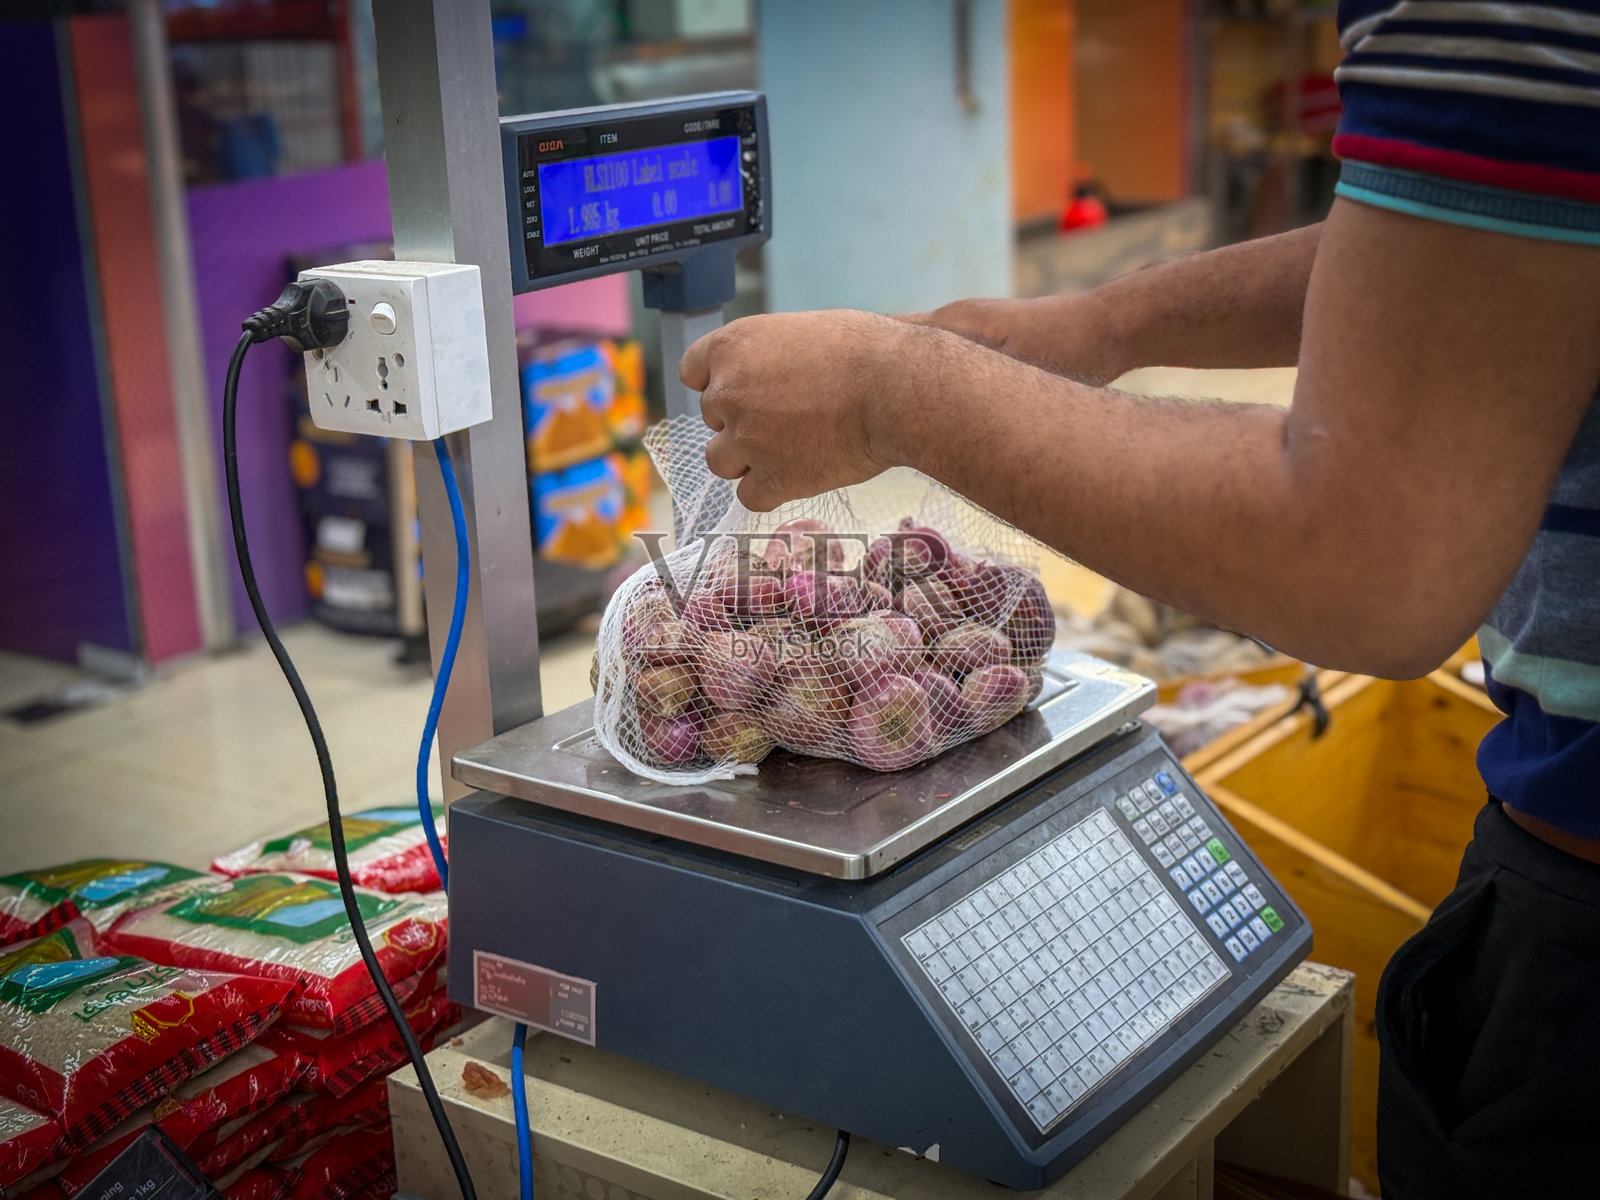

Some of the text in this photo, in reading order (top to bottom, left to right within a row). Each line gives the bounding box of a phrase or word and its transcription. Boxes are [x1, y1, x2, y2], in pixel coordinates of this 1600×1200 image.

[684, 119, 720, 133] CODE/TARE
[600, 133, 618, 144] ITEM
[523, 170, 535, 178] AUTO
[633, 154, 663, 186] Label
[668, 150, 698, 180] scale
[524, 185, 536, 193] LOCK
[652, 189, 678, 218] 0.00
[526, 216, 538, 224] ZERO
[605, 200, 620, 230] kg
[693, 218, 736, 235] TOTAL AMOUNT
[526, 230, 540, 239] STABLE
[636, 231, 670, 247] UNIT PRICE
[573, 245, 600, 260] WEIGHT
[134, 1178, 157, 1198] 1kg
